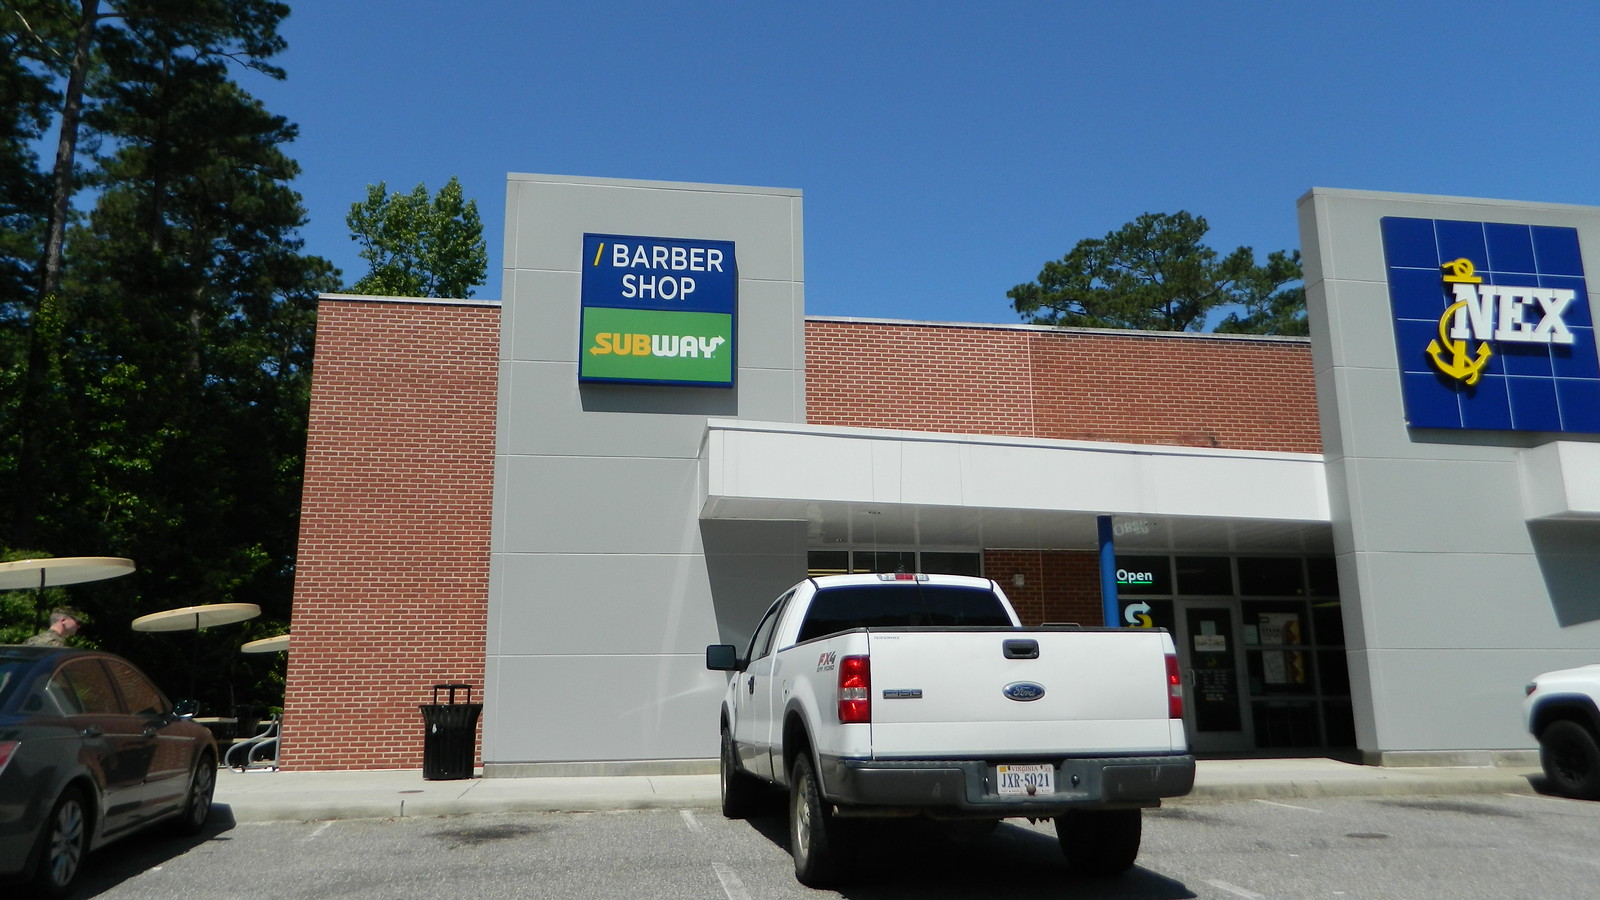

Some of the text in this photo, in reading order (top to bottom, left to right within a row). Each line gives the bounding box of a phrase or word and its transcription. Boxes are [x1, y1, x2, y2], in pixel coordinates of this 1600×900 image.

[612, 244, 723, 272] BARBER
[621, 274, 696, 300] SHOP
[1450, 283, 1575, 344] NEX
[589, 332, 726, 358] SUBWAY
[1116, 569, 1153, 583] Open
[817, 651, 836, 667] FX4
[1013, 686, 1036, 697] Ford
[1001, 772, 1050, 788] JXR-5021
